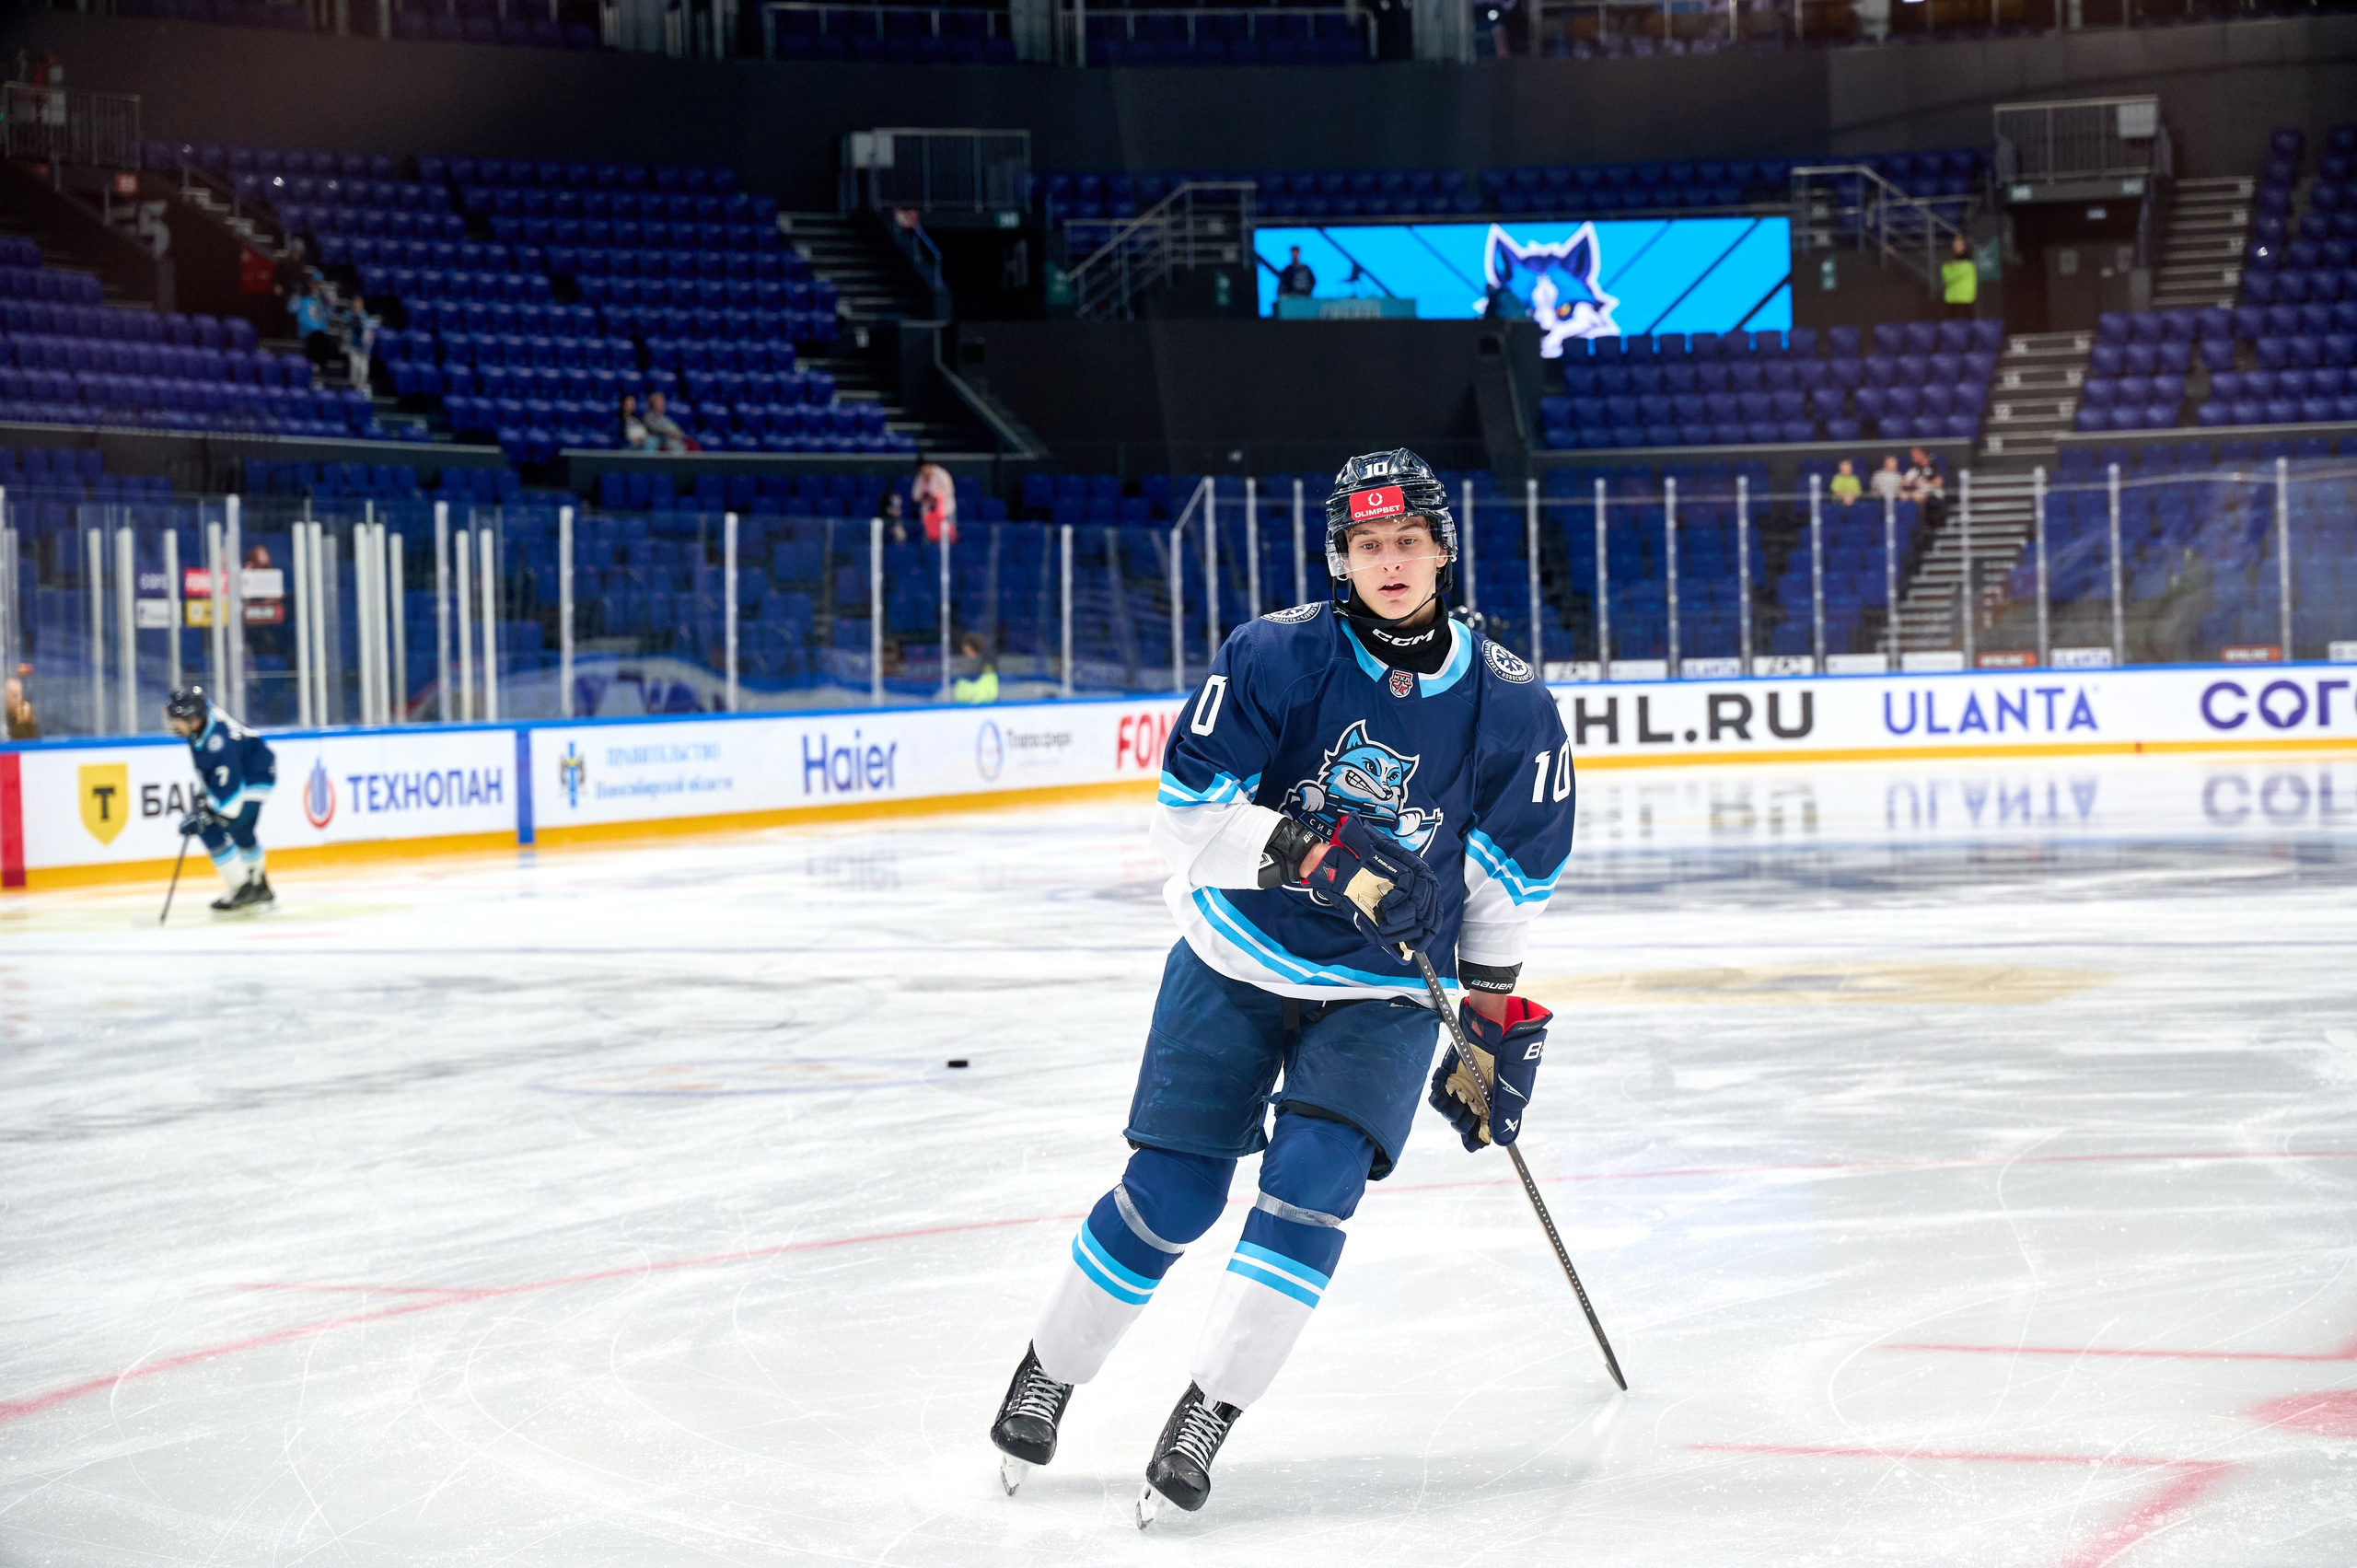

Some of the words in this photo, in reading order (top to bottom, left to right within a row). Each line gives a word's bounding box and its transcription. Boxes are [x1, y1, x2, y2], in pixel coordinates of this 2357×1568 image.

[1365, 461, 1387, 476] 10
[1354, 505, 1400, 518] OLIMPBET
[1373, 628, 1434, 645] CCM
[1554, 691, 1815, 744] HL.RU
[1883, 686, 2099, 735] ULANTA
[2200, 679, 2357, 730] СОГ
[803, 729, 899, 796] Haier
[1531, 734, 1571, 803] 10
[346, 767, 504, 814] ТЕХНОПАН
[1470, 979, 1514, 990] BAUER
